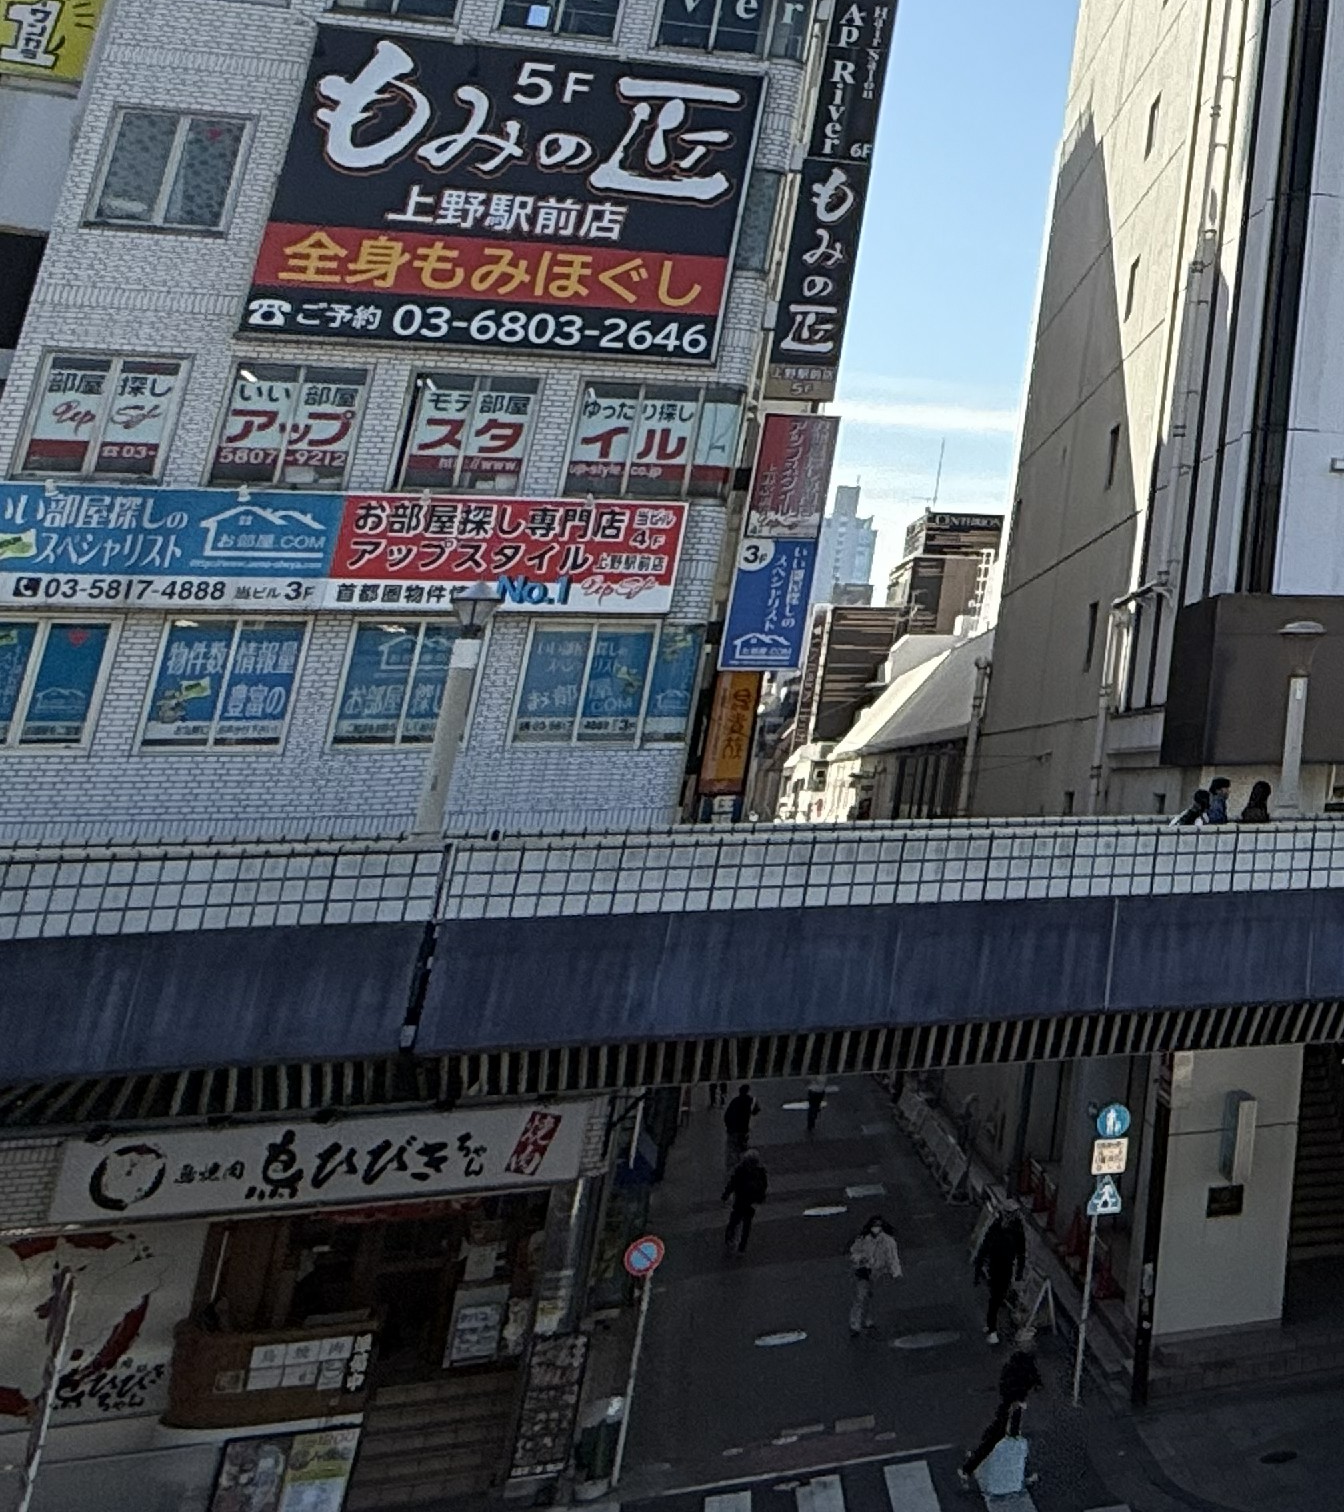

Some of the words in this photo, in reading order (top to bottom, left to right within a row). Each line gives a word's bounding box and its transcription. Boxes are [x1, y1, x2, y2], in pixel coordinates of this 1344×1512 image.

[514, 62, 591, 108] 5F
[315, 38, 744, 202] もみの匠
[850, 142, 871, 158] 6F
[386, 185, 629, 243] 上野駅前店
[278, 232, 703, 312] 全身もみほぐし
[294, 302, 382, 333] ご予約
[392, 303, 709, 357] 03-6803-2646
[47, 372, 172, 398] 部屋探し
[237, 383, 358, 407] いい部屋
[427, 392, 532, 416] モテ部屋
[582, 399, 694, 423] ゆったり探し
[354, 500, 629, 541] お部屋探し専門店
[34, 532, 182, 569] スペシャリスト
[347, 538, 592, 575] アップスタイル
[629, 530, 664, 550] 4F
[742, 544, 768, 564] 3F
[44, 578, 227, 602] 03-5817-4888
[283, 581, 315, 602] 3F
[496, 573, 572, 606] No.1
